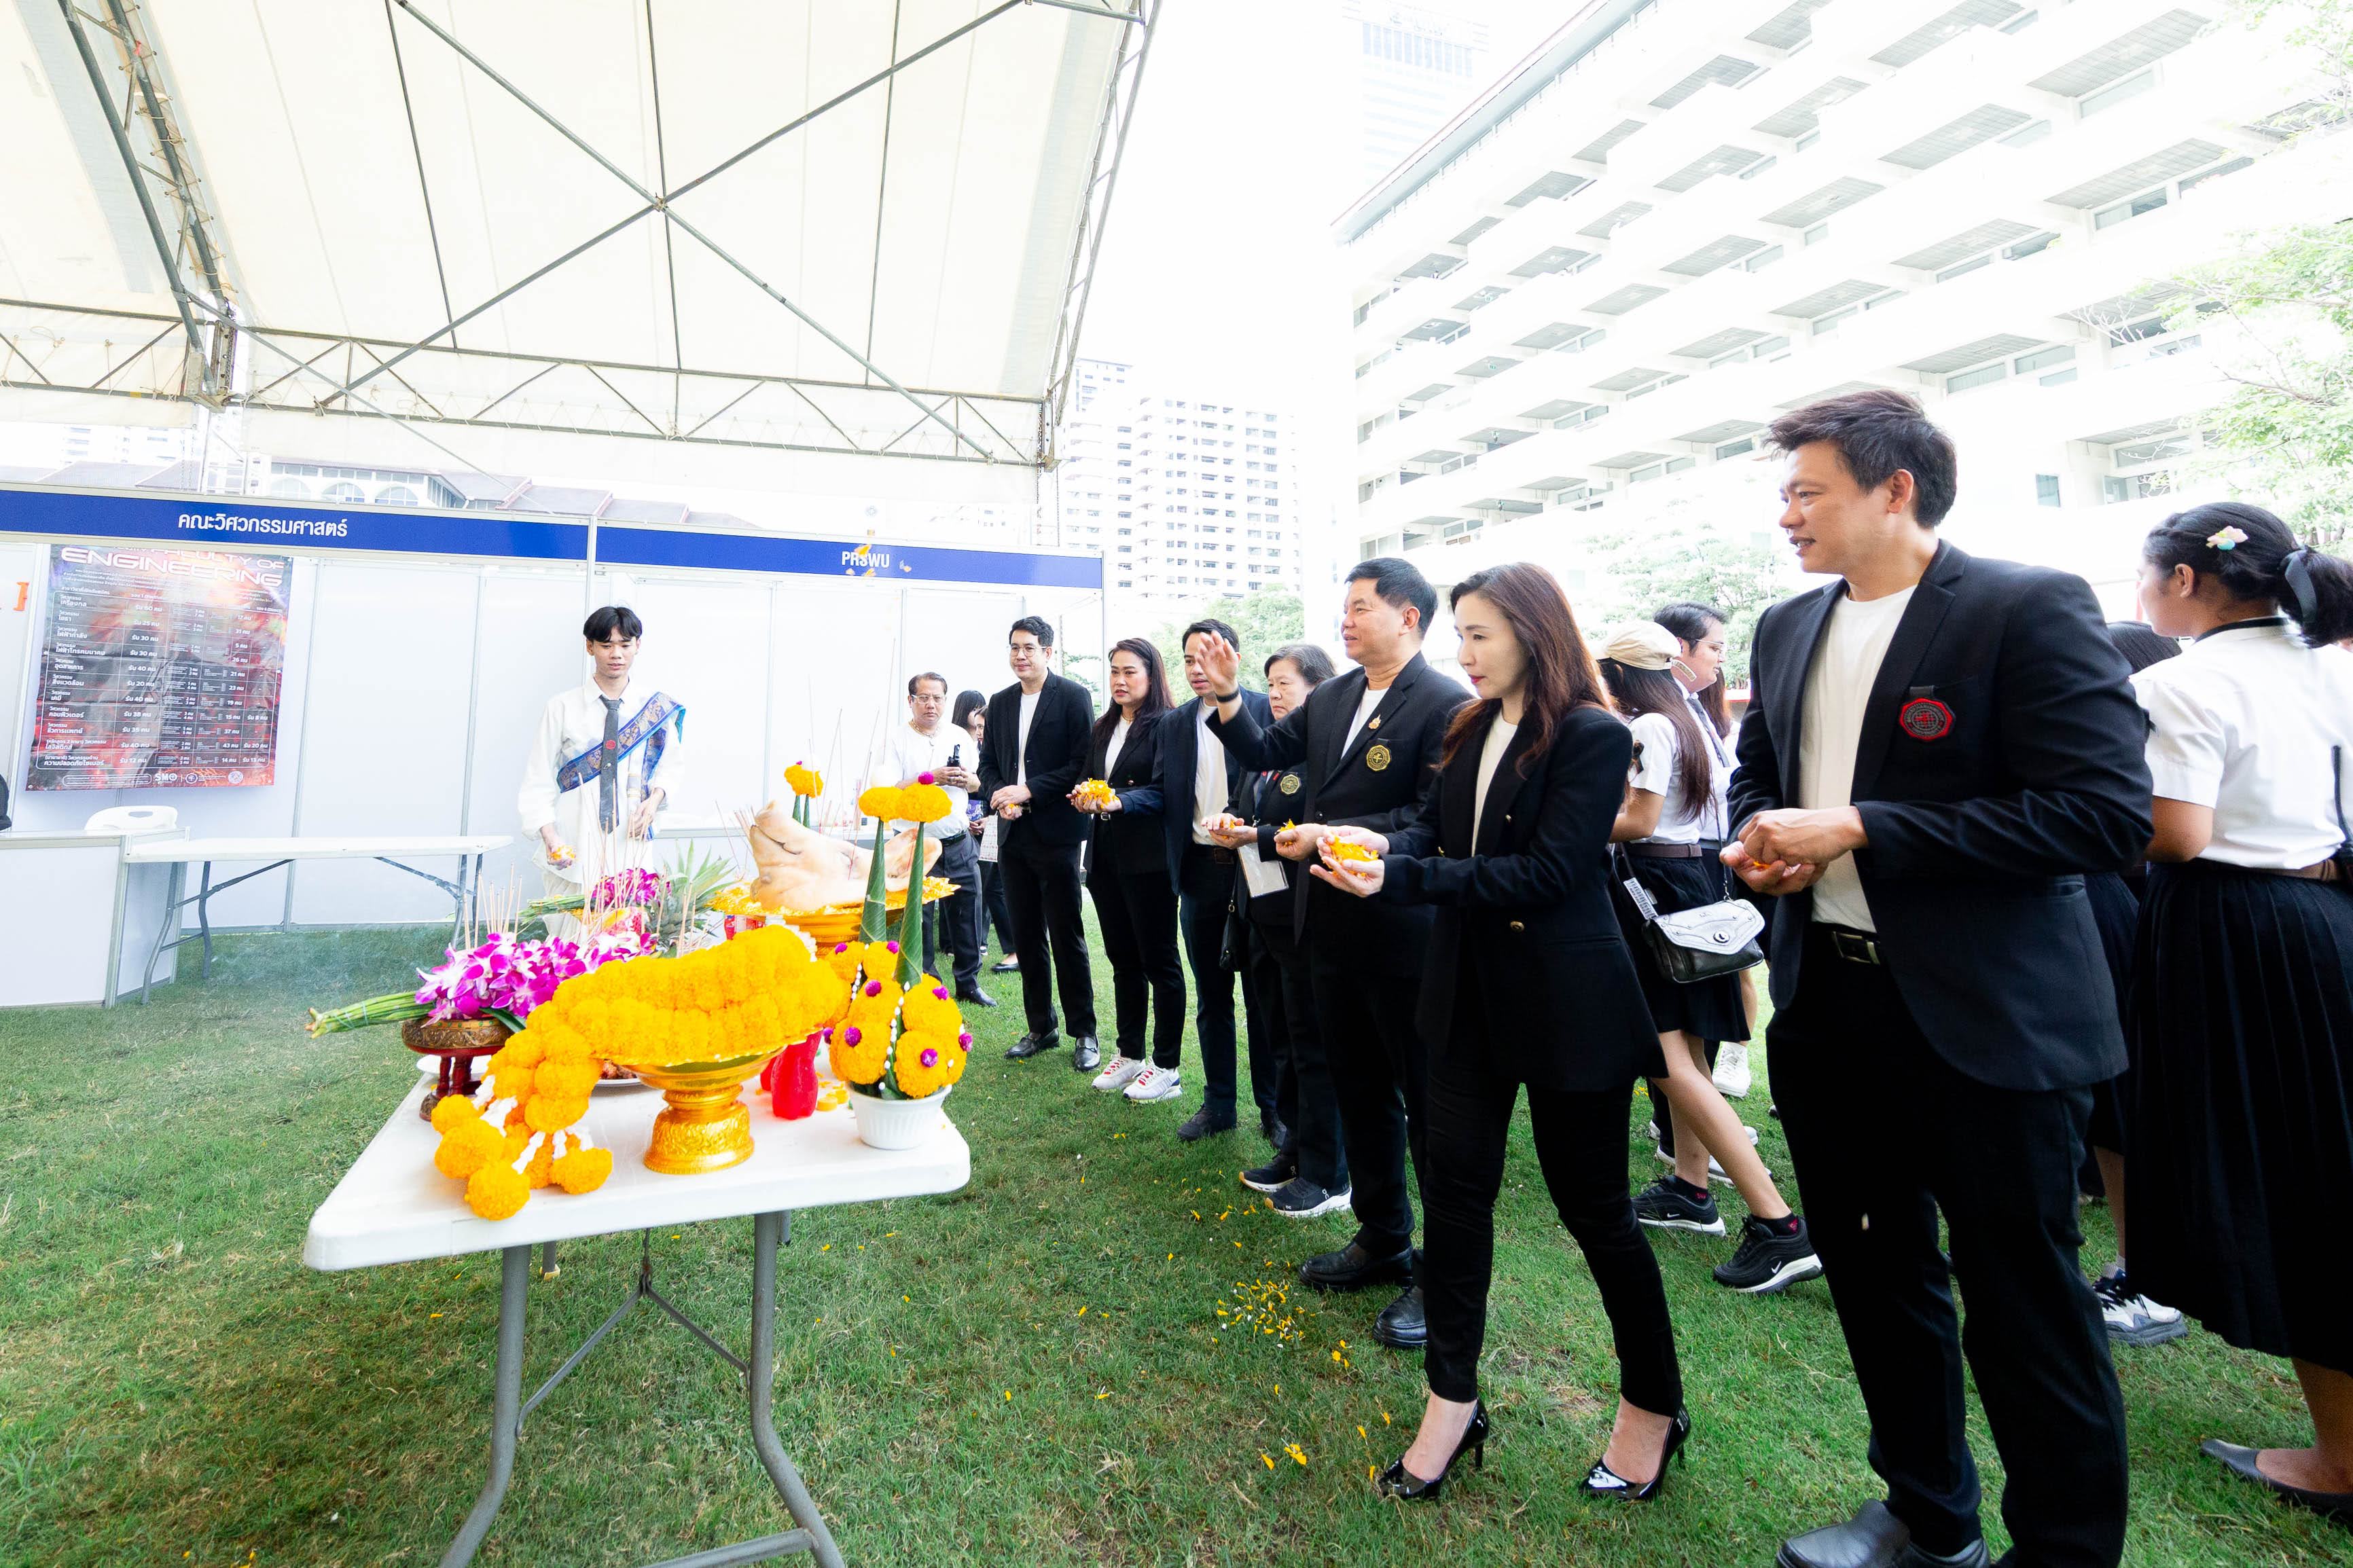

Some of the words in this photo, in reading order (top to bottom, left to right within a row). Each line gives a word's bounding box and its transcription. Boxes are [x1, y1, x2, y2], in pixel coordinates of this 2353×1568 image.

[178, 513, 348, 537] คณะวิศวกรรมศาสตร์
[61, 546, 283, 587] ENGINEERING
[257, 559, 285, 569] OF
[841, 551, 890, 568] PRSWU
